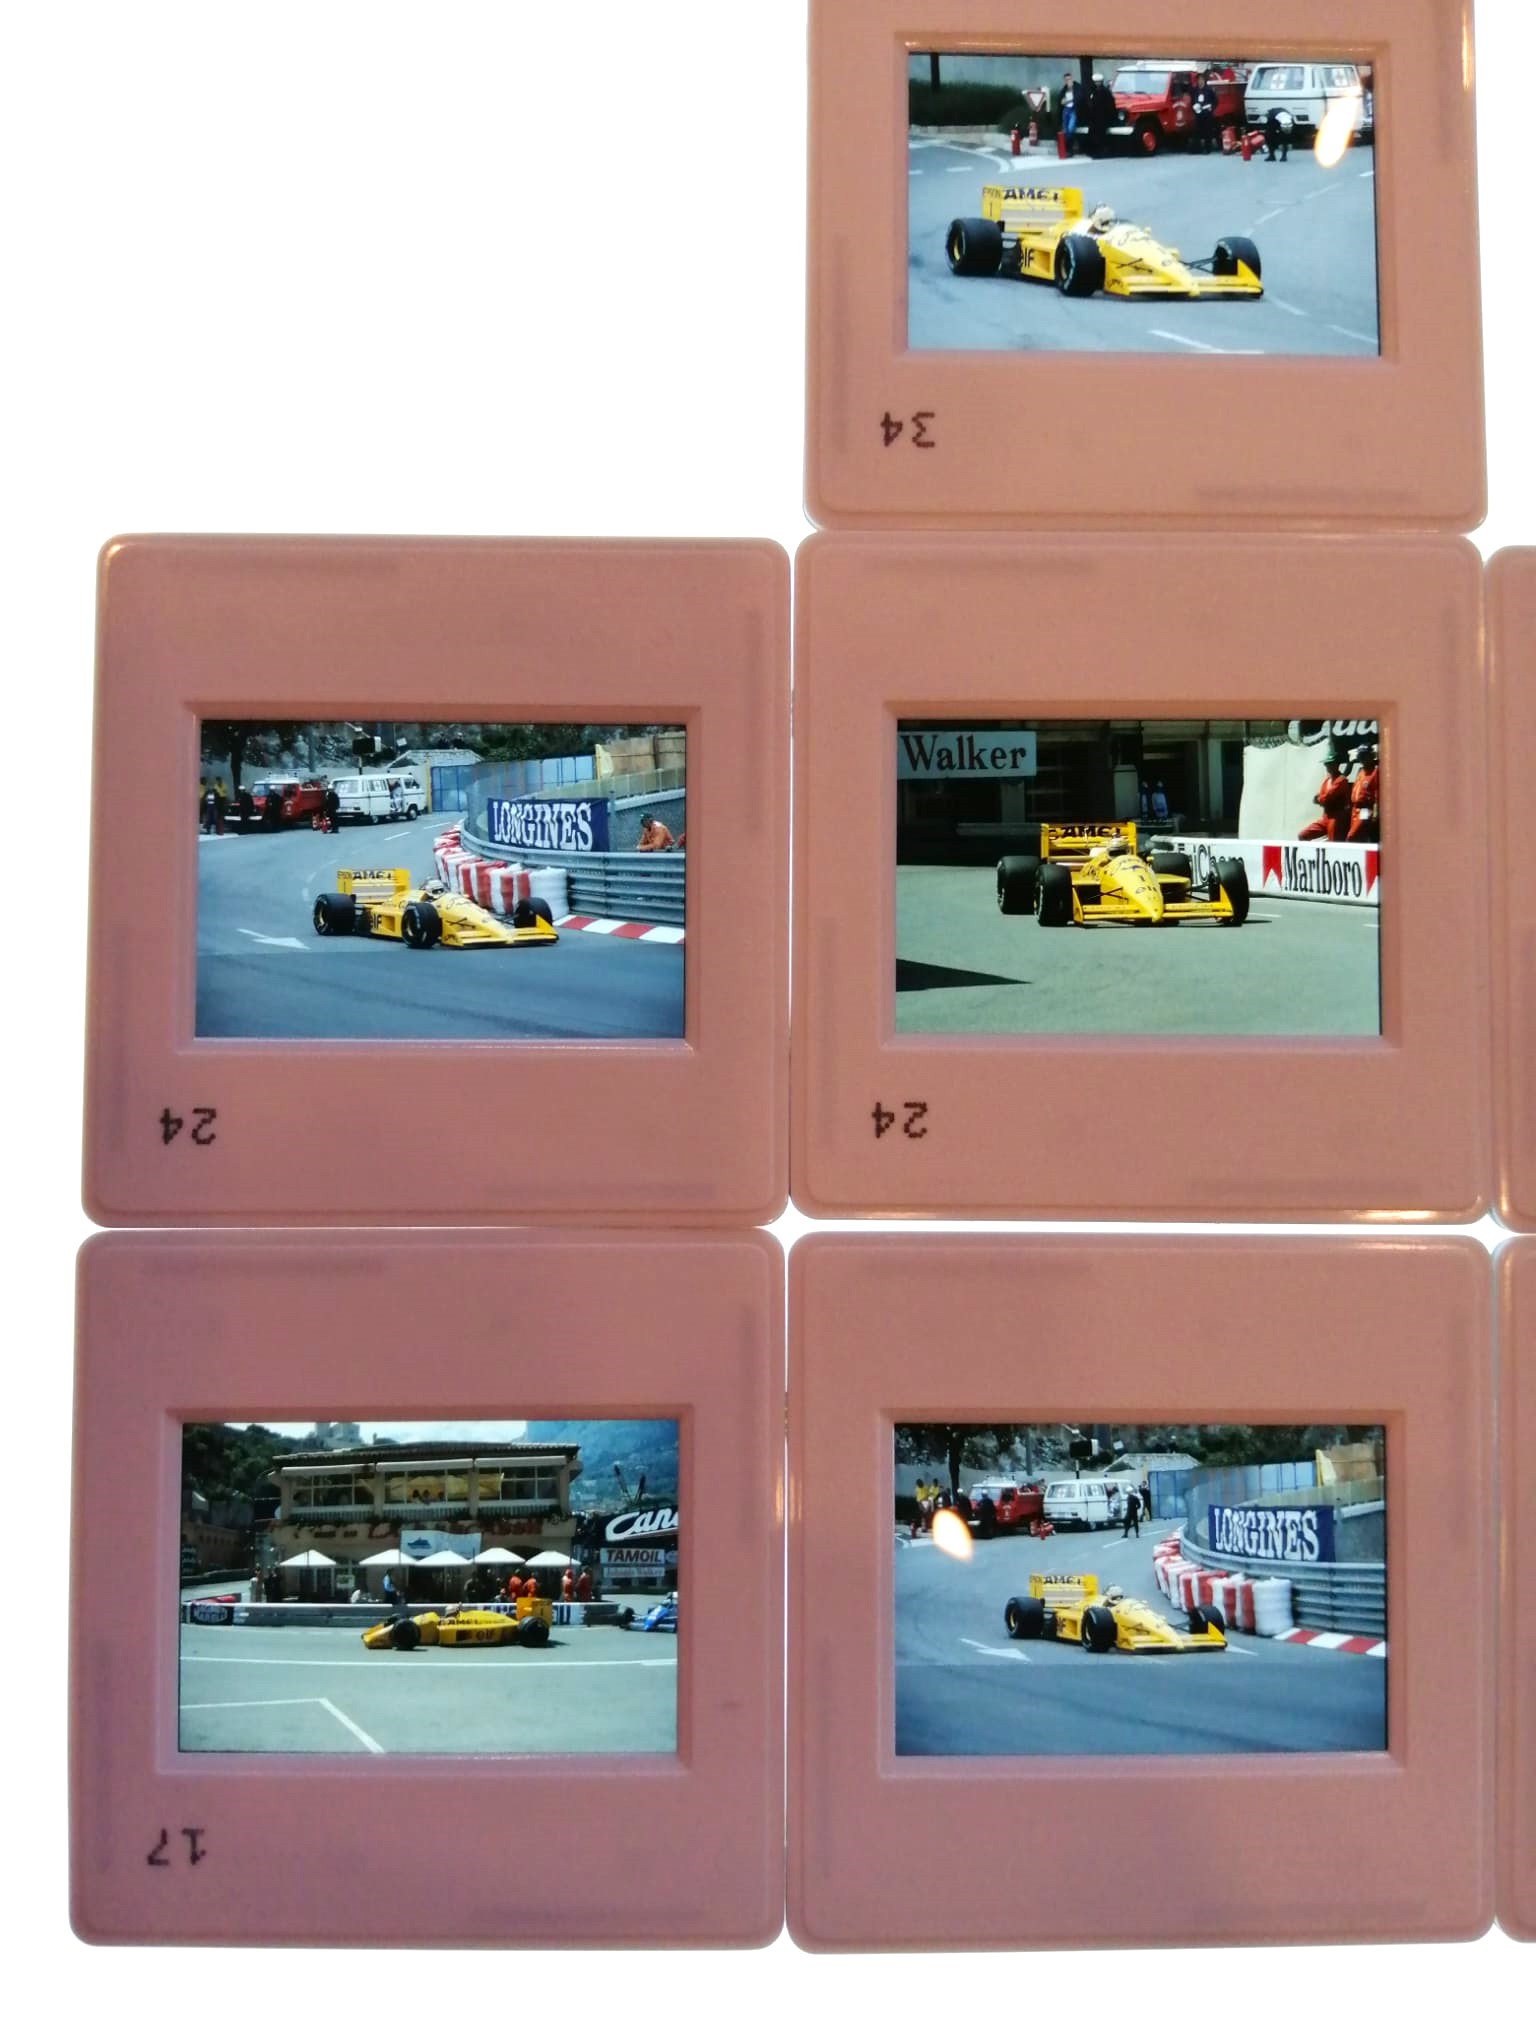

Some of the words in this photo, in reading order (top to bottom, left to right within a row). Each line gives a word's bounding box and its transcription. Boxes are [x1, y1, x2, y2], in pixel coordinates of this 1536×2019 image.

[1003, 188, 1060, 201] AMEL
[880, 411, 936, 448] 34
[901, 734, 1027, 772] Walker
[493, 801, 594, 851] LONGINES
[352, 871, 393, 880] AMEL
[1284, 846, 1363, 897] Marlboro
[160, 1107, 217, 1145] 24
[872, 1102, 928, 1139] 24
[1214, 1508, 1320, 1561] LONGINES
[607, 1549, 661, 1563] TAMOIL
[1043, 1574, 1082, 1585] AMEL
[147, 1828, 206, 1866] 17
